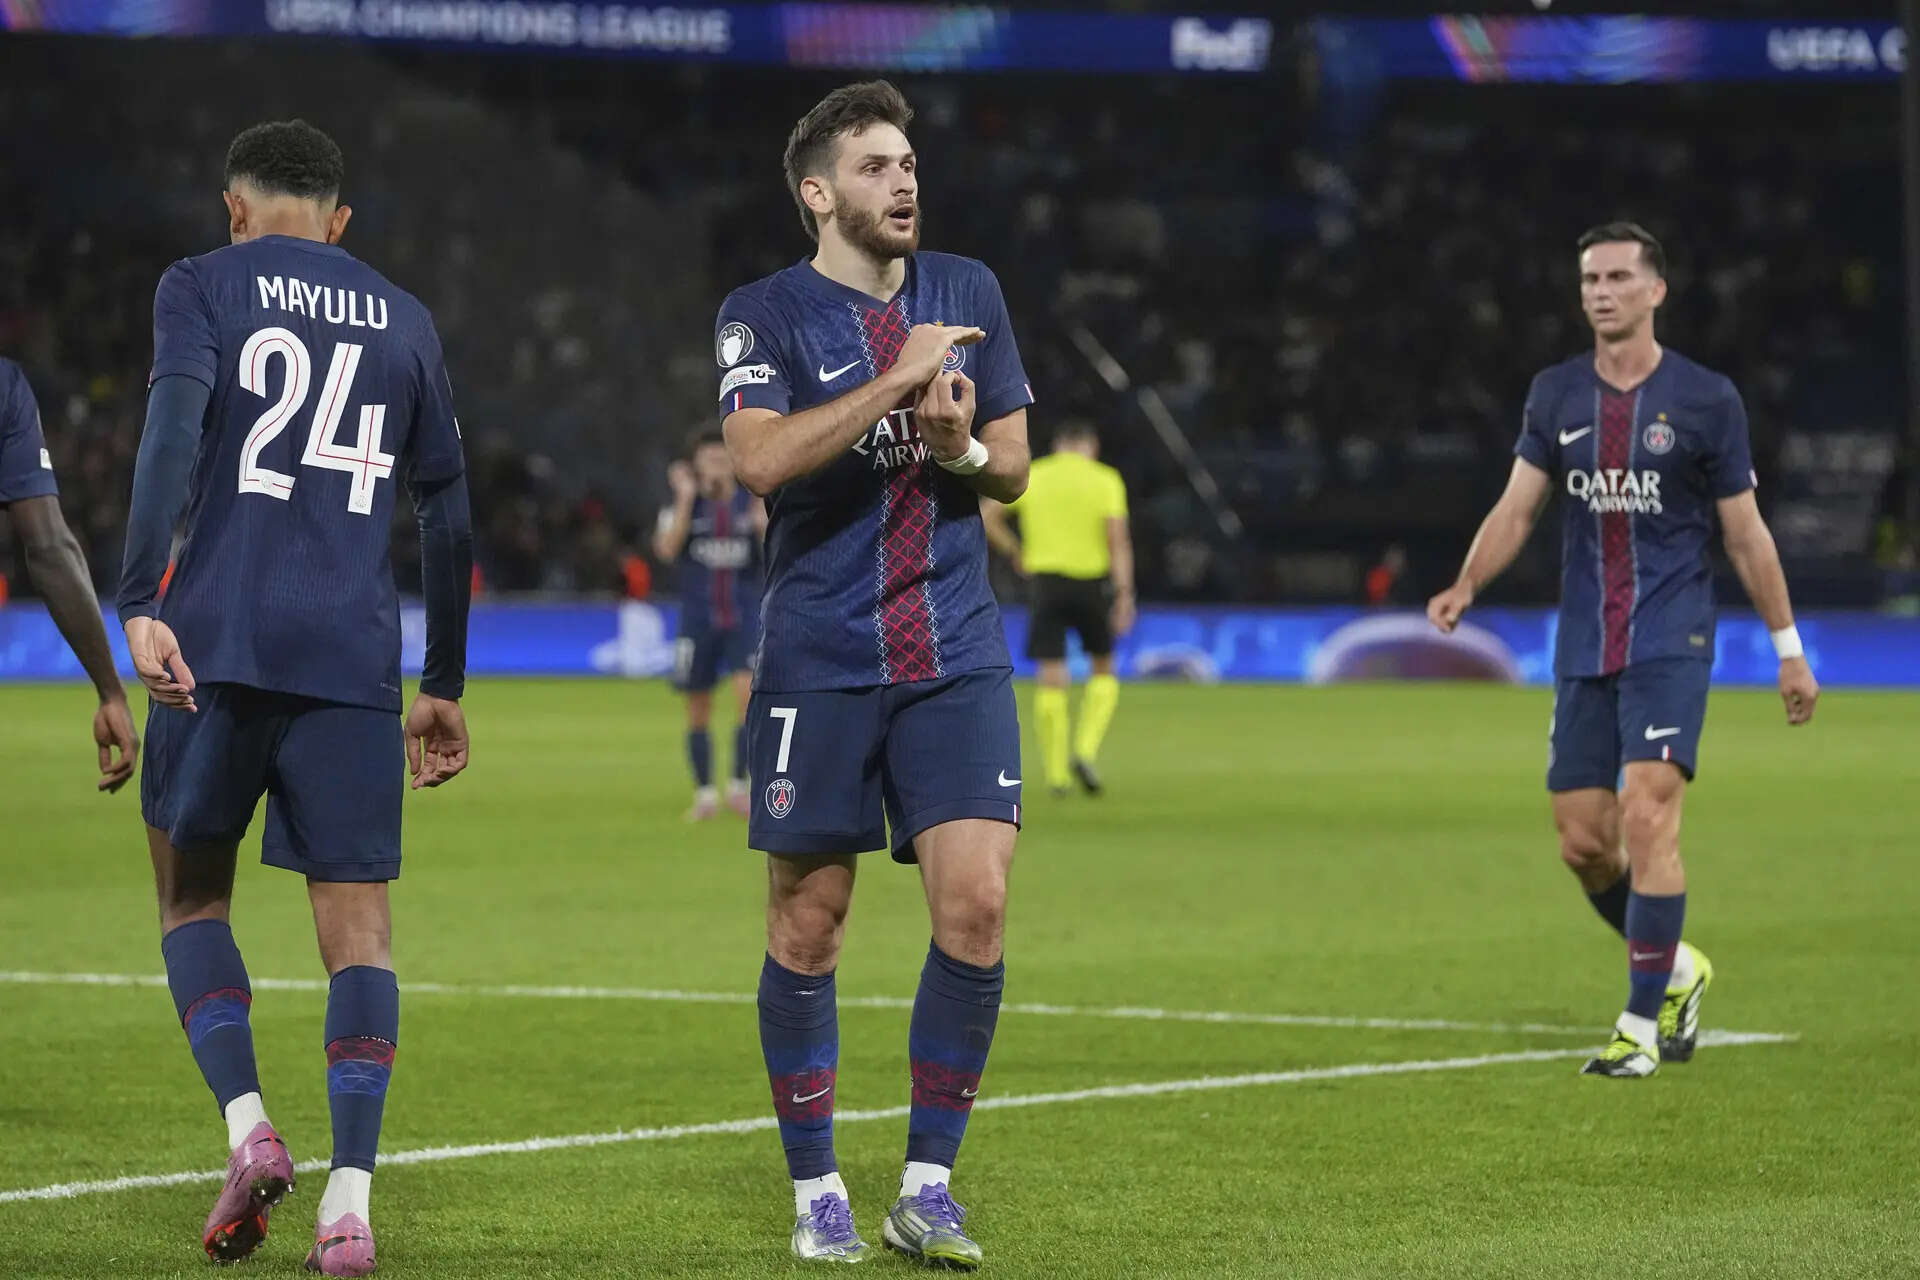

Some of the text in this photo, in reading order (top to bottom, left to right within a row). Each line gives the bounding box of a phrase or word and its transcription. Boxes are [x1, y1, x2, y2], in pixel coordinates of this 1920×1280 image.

[579, 4, 731, 53] LEAGUE
[1768, 26, 1879, 72] UEFA
[256, 275, 389, 330] MAYULU
[238, 326, 396, 516] 24
[873, 441, 932, 471] AIRW
[1566, 467, 1662, 501] QATAR
[1588, 495, 1664, 515] AIRWAYS
[769, 707, 798, 773] 7
[771, 781, 792, 791] PARIS
